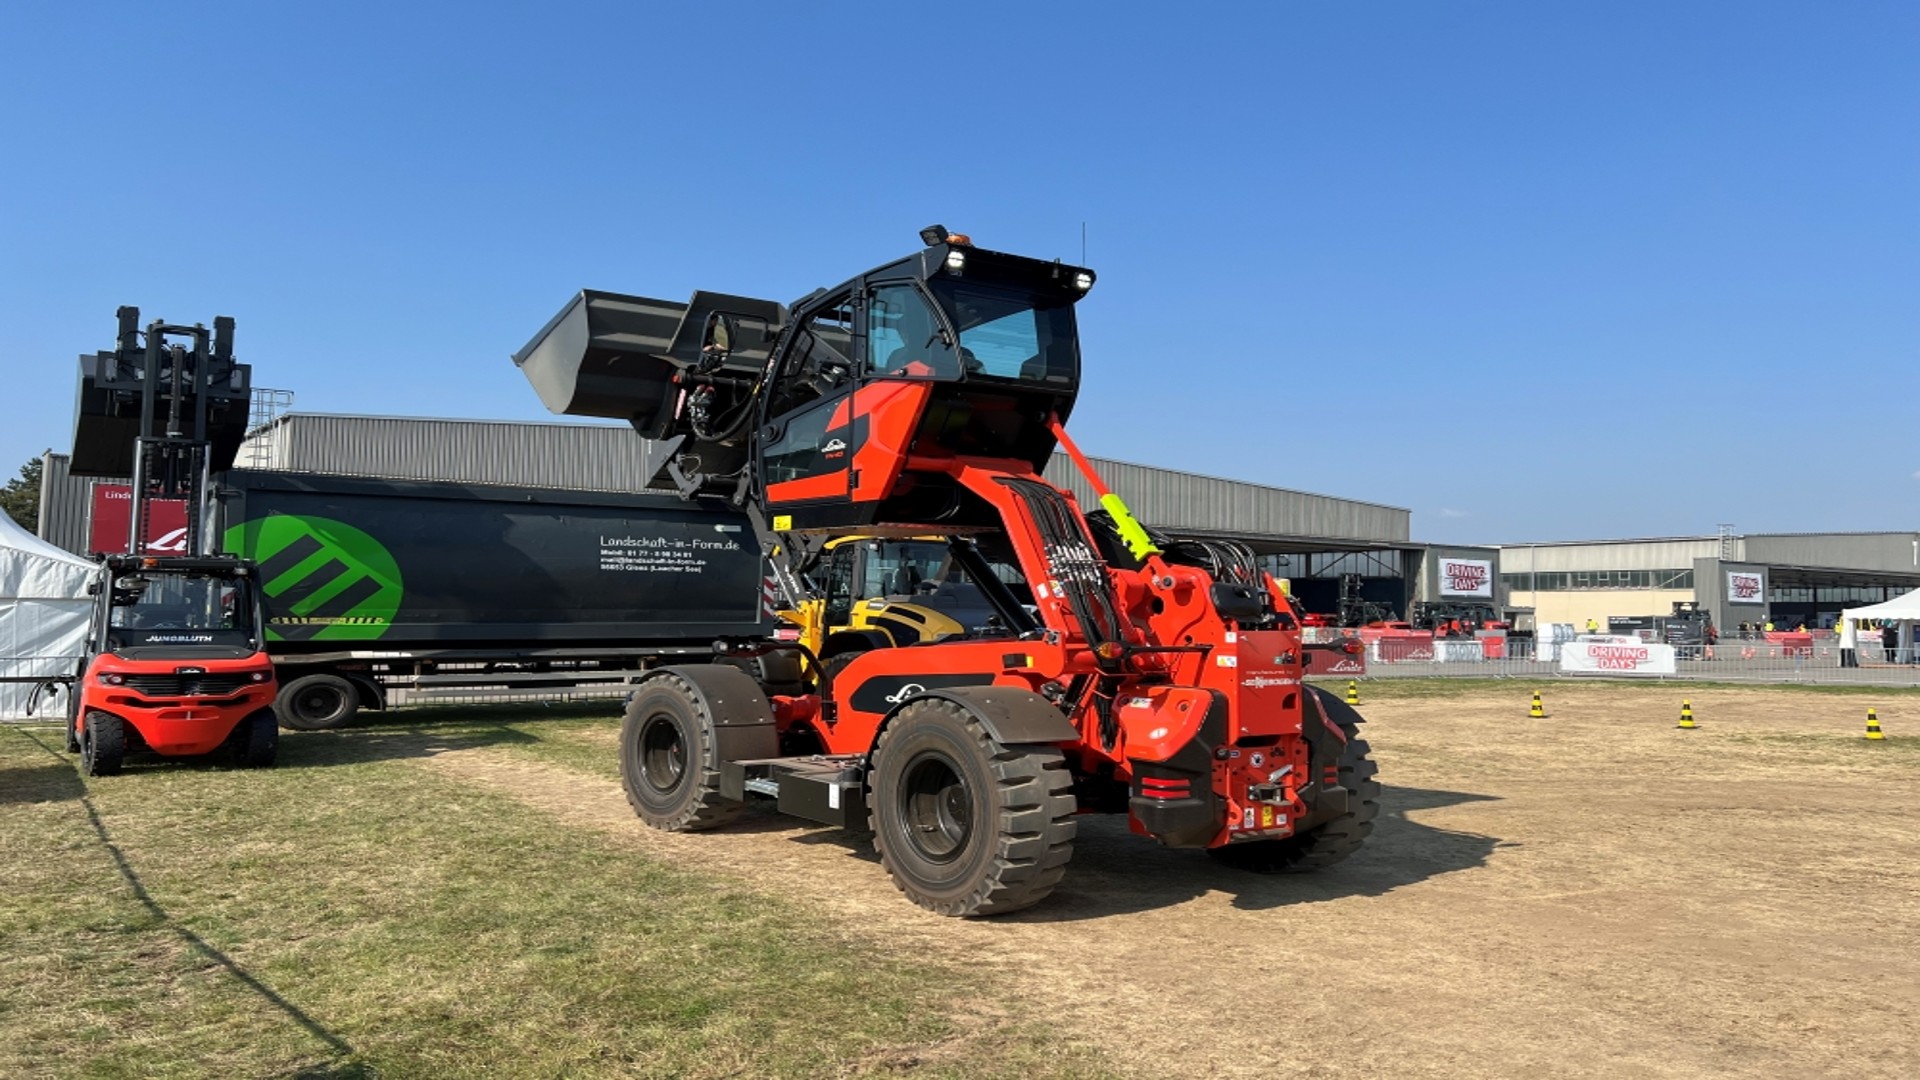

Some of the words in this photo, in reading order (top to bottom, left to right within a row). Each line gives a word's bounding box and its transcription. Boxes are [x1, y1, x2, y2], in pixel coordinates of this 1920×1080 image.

[600, 536, 740, 550] Landschaft-in-Form.de
[1447, 564, 1487, 577] DRIVING
[1454, 578, 1478, 590] DAYS
[1589, 646, 1648, 659] DRIVING
[1326, 659, 1362, 672] Linde
[1600, 658, 1636, 669] DAYS
